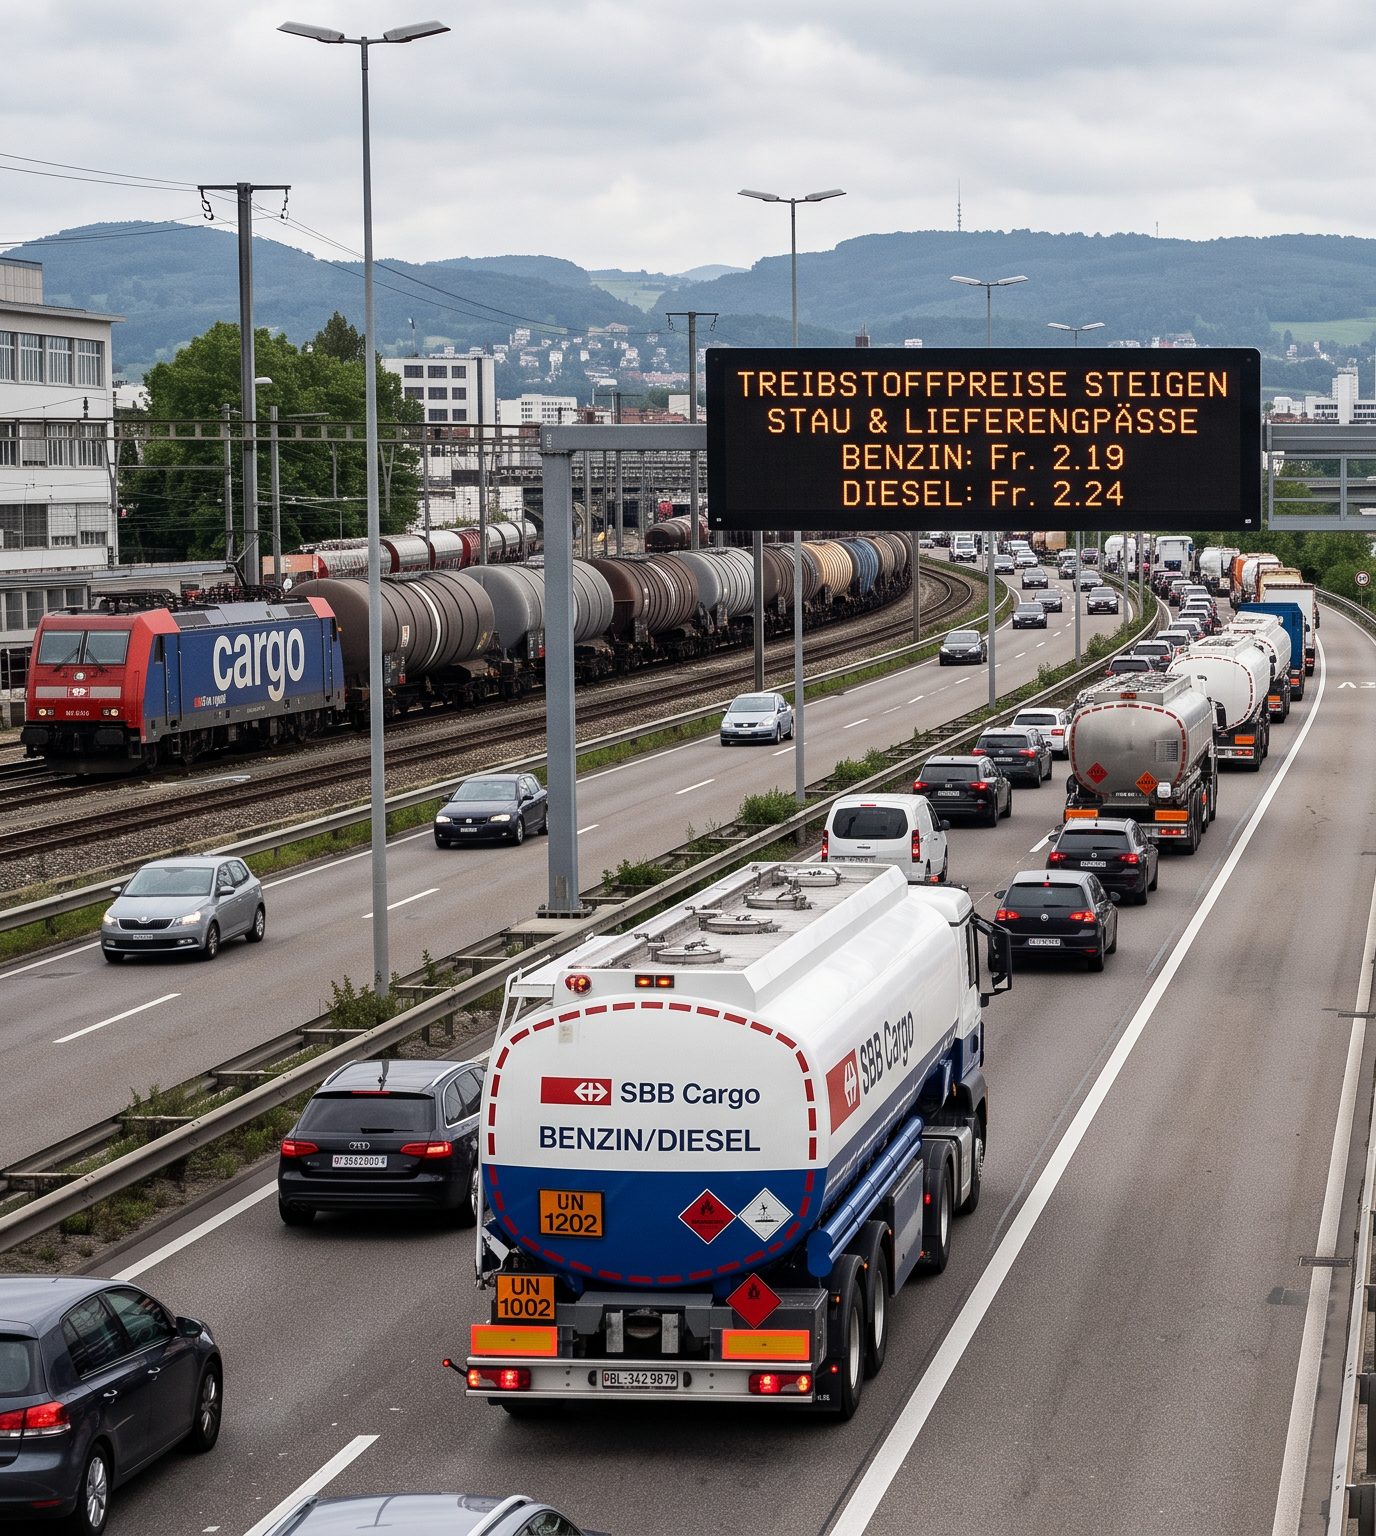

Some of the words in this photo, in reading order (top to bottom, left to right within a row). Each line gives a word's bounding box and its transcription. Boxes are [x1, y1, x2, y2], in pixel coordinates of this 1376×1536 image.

[738, 371, 1067, 398] TREIBSTOFFPREISE
[1085, 371, 1228, 398] STEIGEN
[767, 407, 851, 434] STAU
[868, 407, 888, 434] &
[905, 404, 1199, 434] LIEFERENGPÄSSE
[842, 444, 973, 470] BENZIN:
[991, 444, 1035, 470] Fr.
[1053, 444, 1124, 470] 2.19
[843, 480, 973, 506] DIESEL:
[991, 480, 1035, 506] Fr.
[1053, 480, 1124, 506] 2.24
[213, 627, 305, 702] cargo
[860, 1031, 884, 1095] SBB
[883, 1010, 914, 1071] Cargo
[620, 1082, 675, 1104] SBB
[682, 1082, 761, 1110] Cargo
[539, 1125, 761, 1153] BENZIN/DIESEL
[557, 1193, 584, 1211] UN
[544, 1213, 598, 1233] 1202
[511, 1278, 540, 1296] UN
[499, 1298, 551, 1317] 1002
